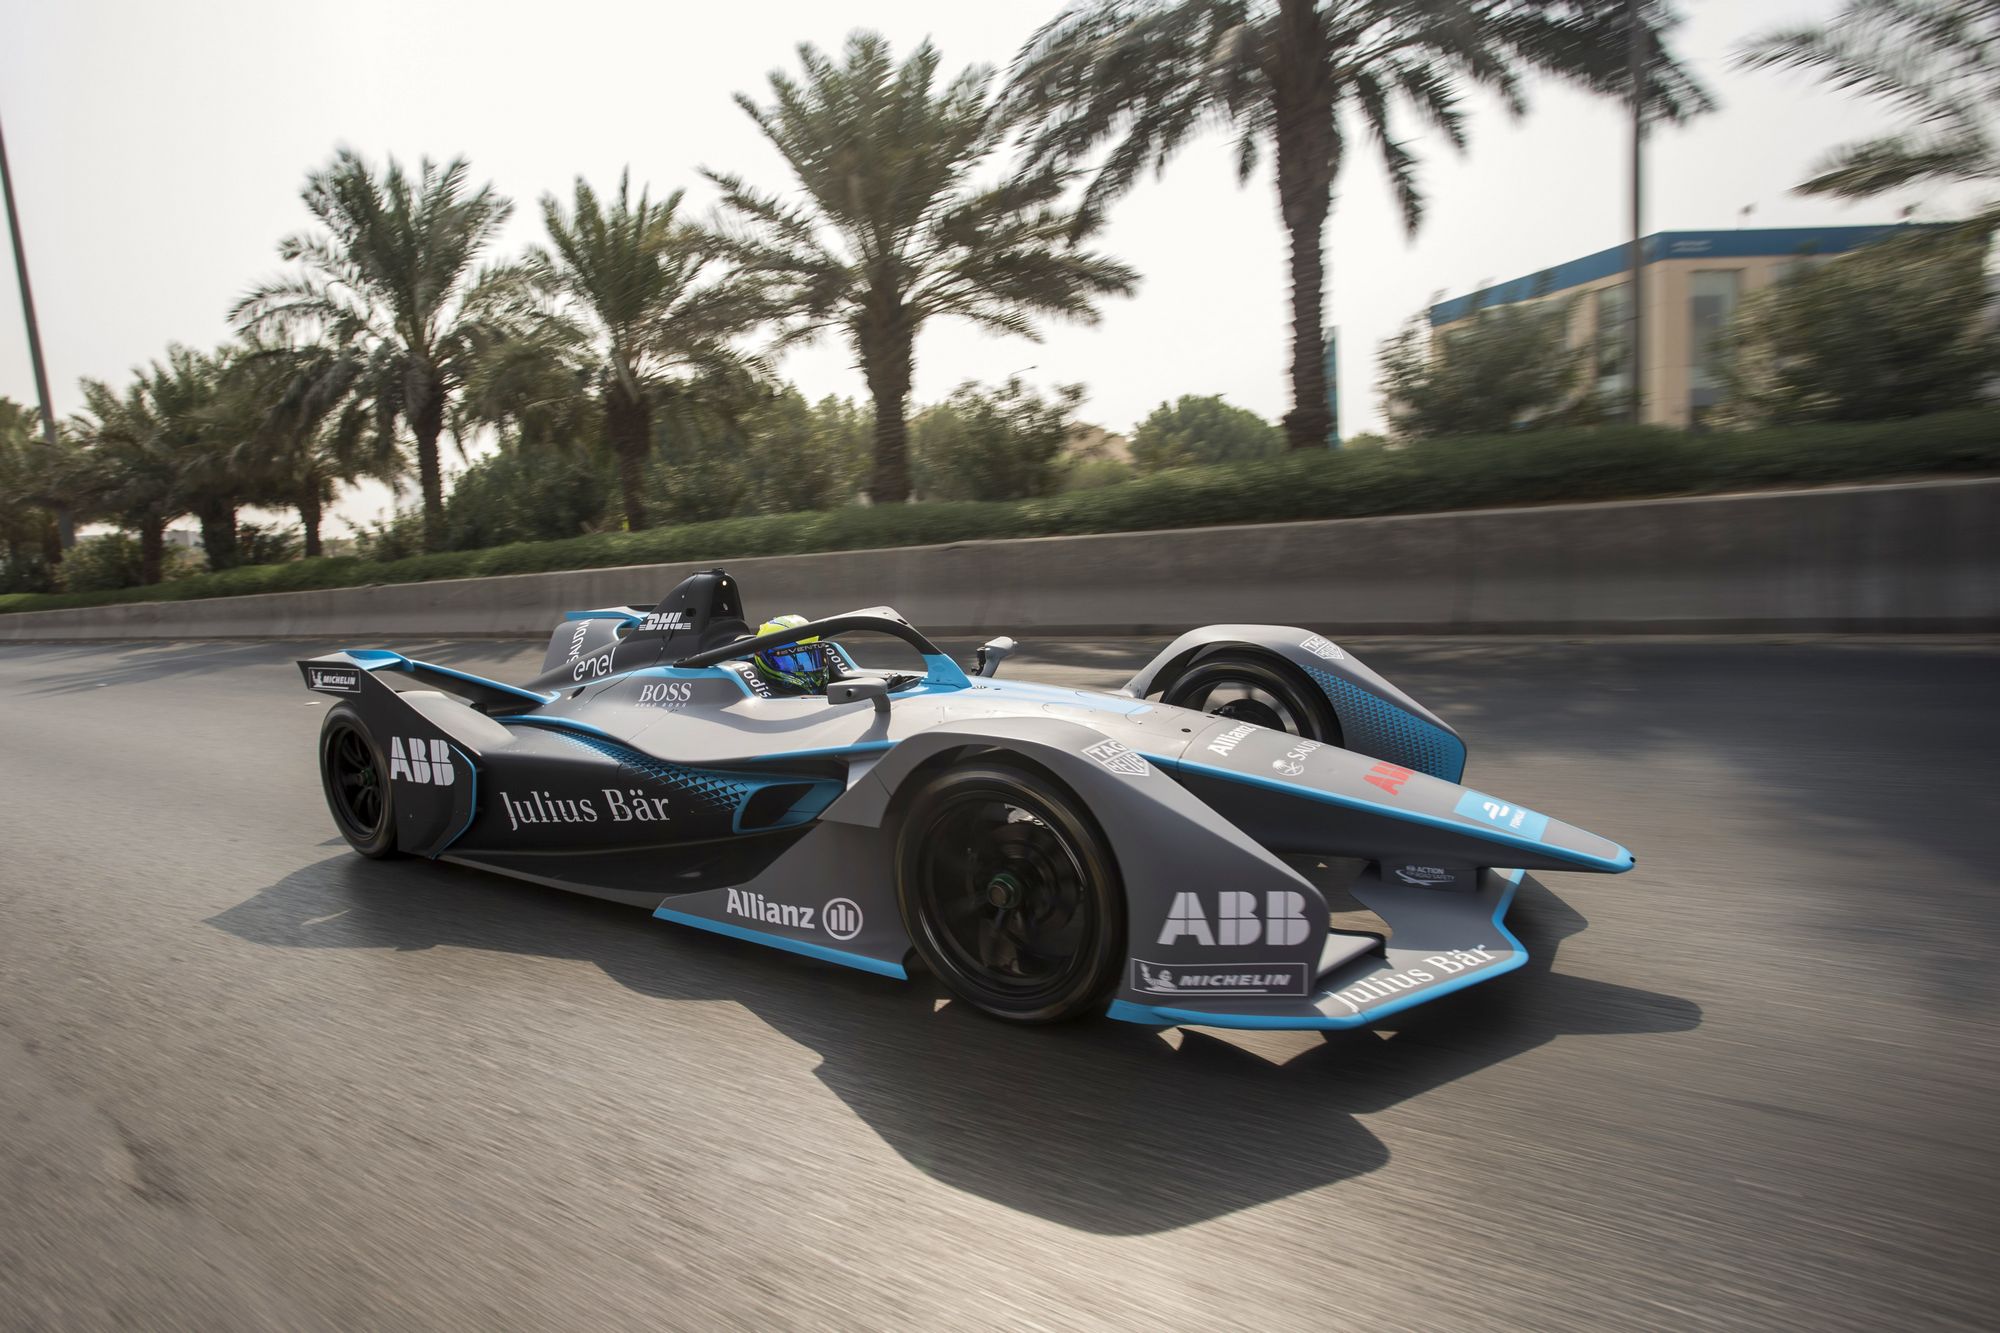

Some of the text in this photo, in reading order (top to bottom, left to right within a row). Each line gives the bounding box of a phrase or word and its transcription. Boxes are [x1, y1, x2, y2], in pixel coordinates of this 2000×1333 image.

[644, 612, 685, 631] DHL
[323, 675, 356, 685] MICHELIN
[573, 646, 617, 681] enel
[638, 682, 692, 702] BOSS
[390, 736, 455, 786] ABB
[1088, 741, 1128, 759] TAG
[1363, 761, 1416, 796] AB
[500, 788, 670, 831] Julius Bär
[1416, 866, 1444, 875] ACTION
[726, 888, 815, 929] Allianz
[1156, 891, 1311, 946] ABB
[1178, 974, 1291, 986] MICHELIN
[1322, 944, 1496, 1013] Julius Bär
